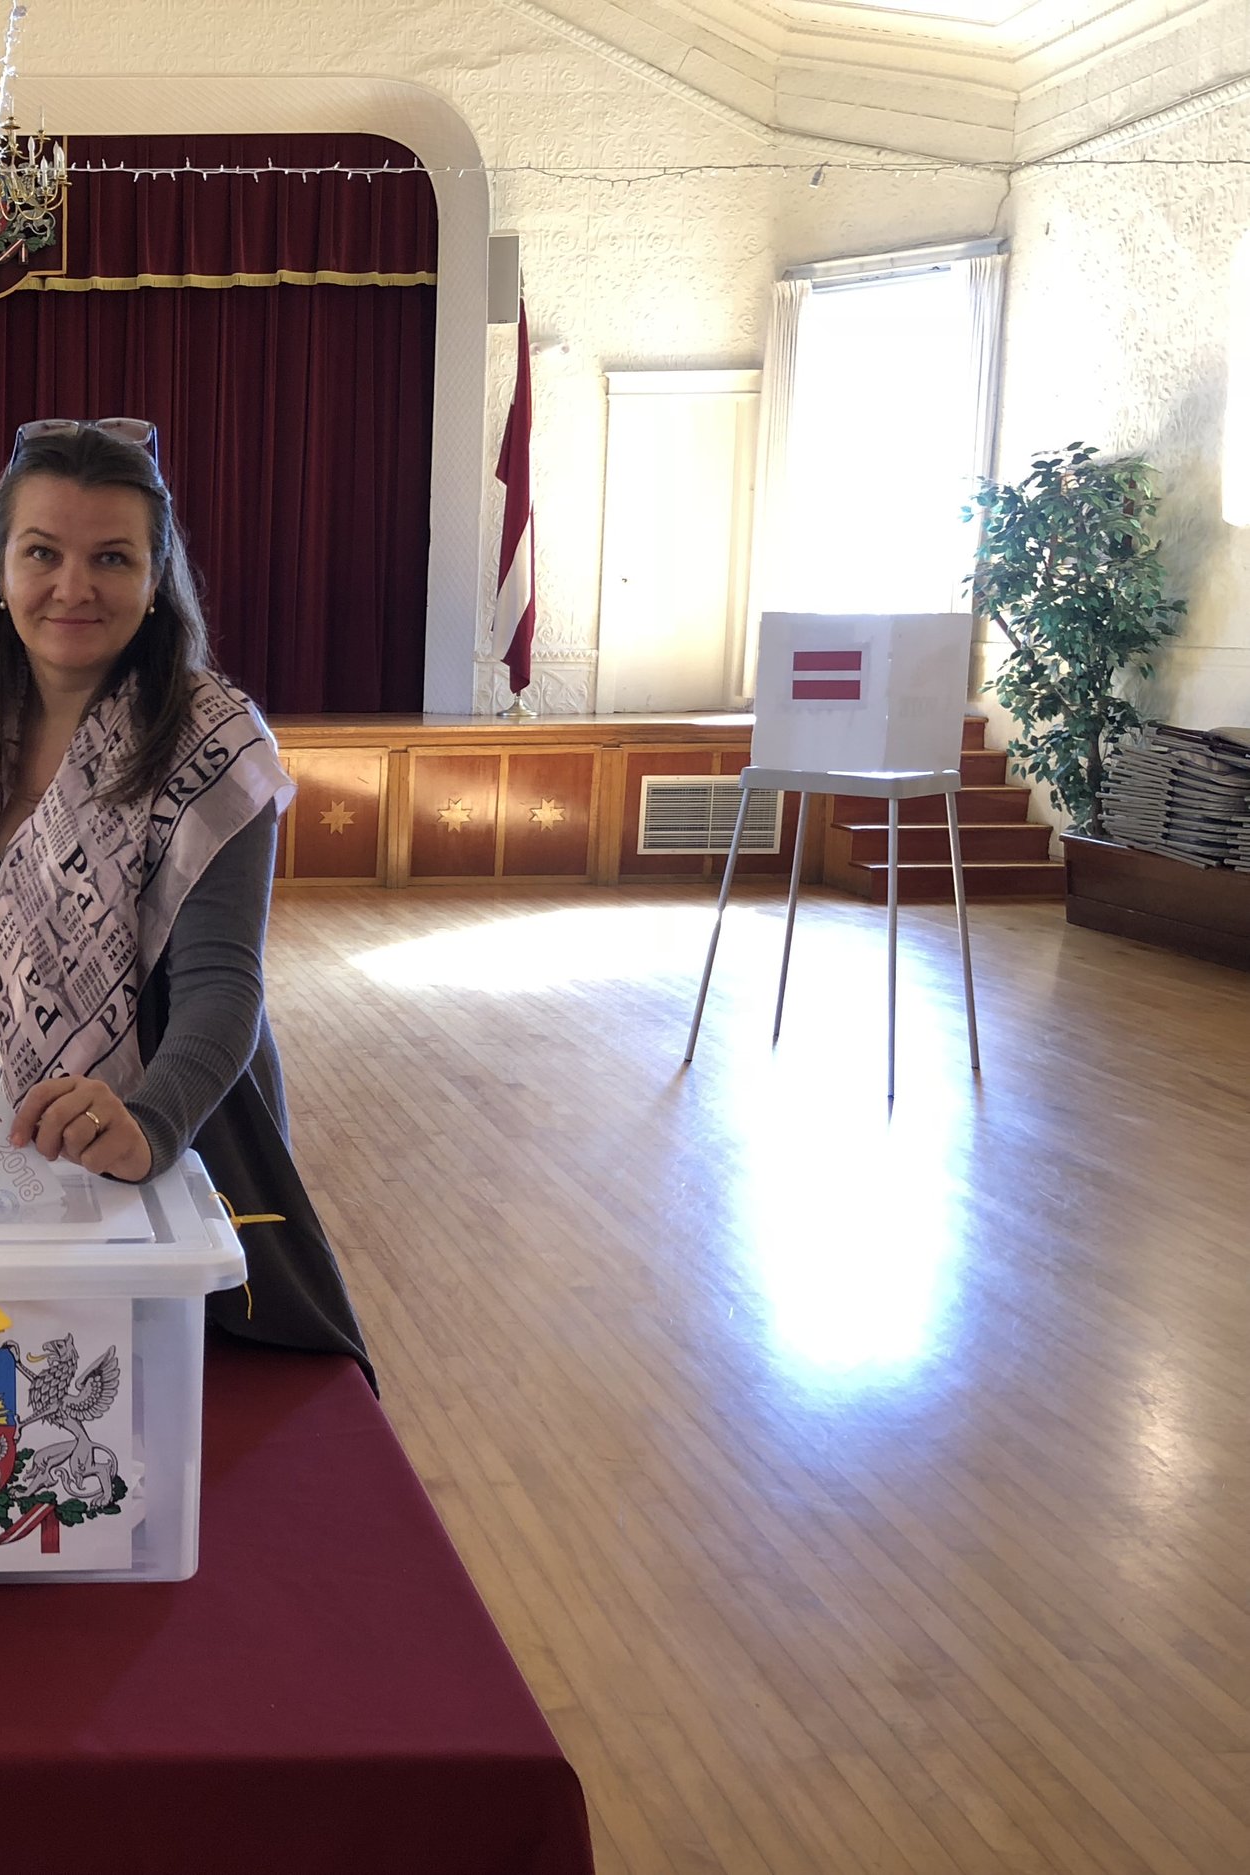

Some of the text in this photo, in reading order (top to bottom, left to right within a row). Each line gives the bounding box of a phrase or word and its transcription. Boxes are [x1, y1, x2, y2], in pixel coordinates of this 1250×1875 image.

[144, 738, 229, 872] ARIS
[95, 814, 123, 845] PARIS
[3, 929, 21, 960] PARIS
[101, 922, 129, 952] PARIS
